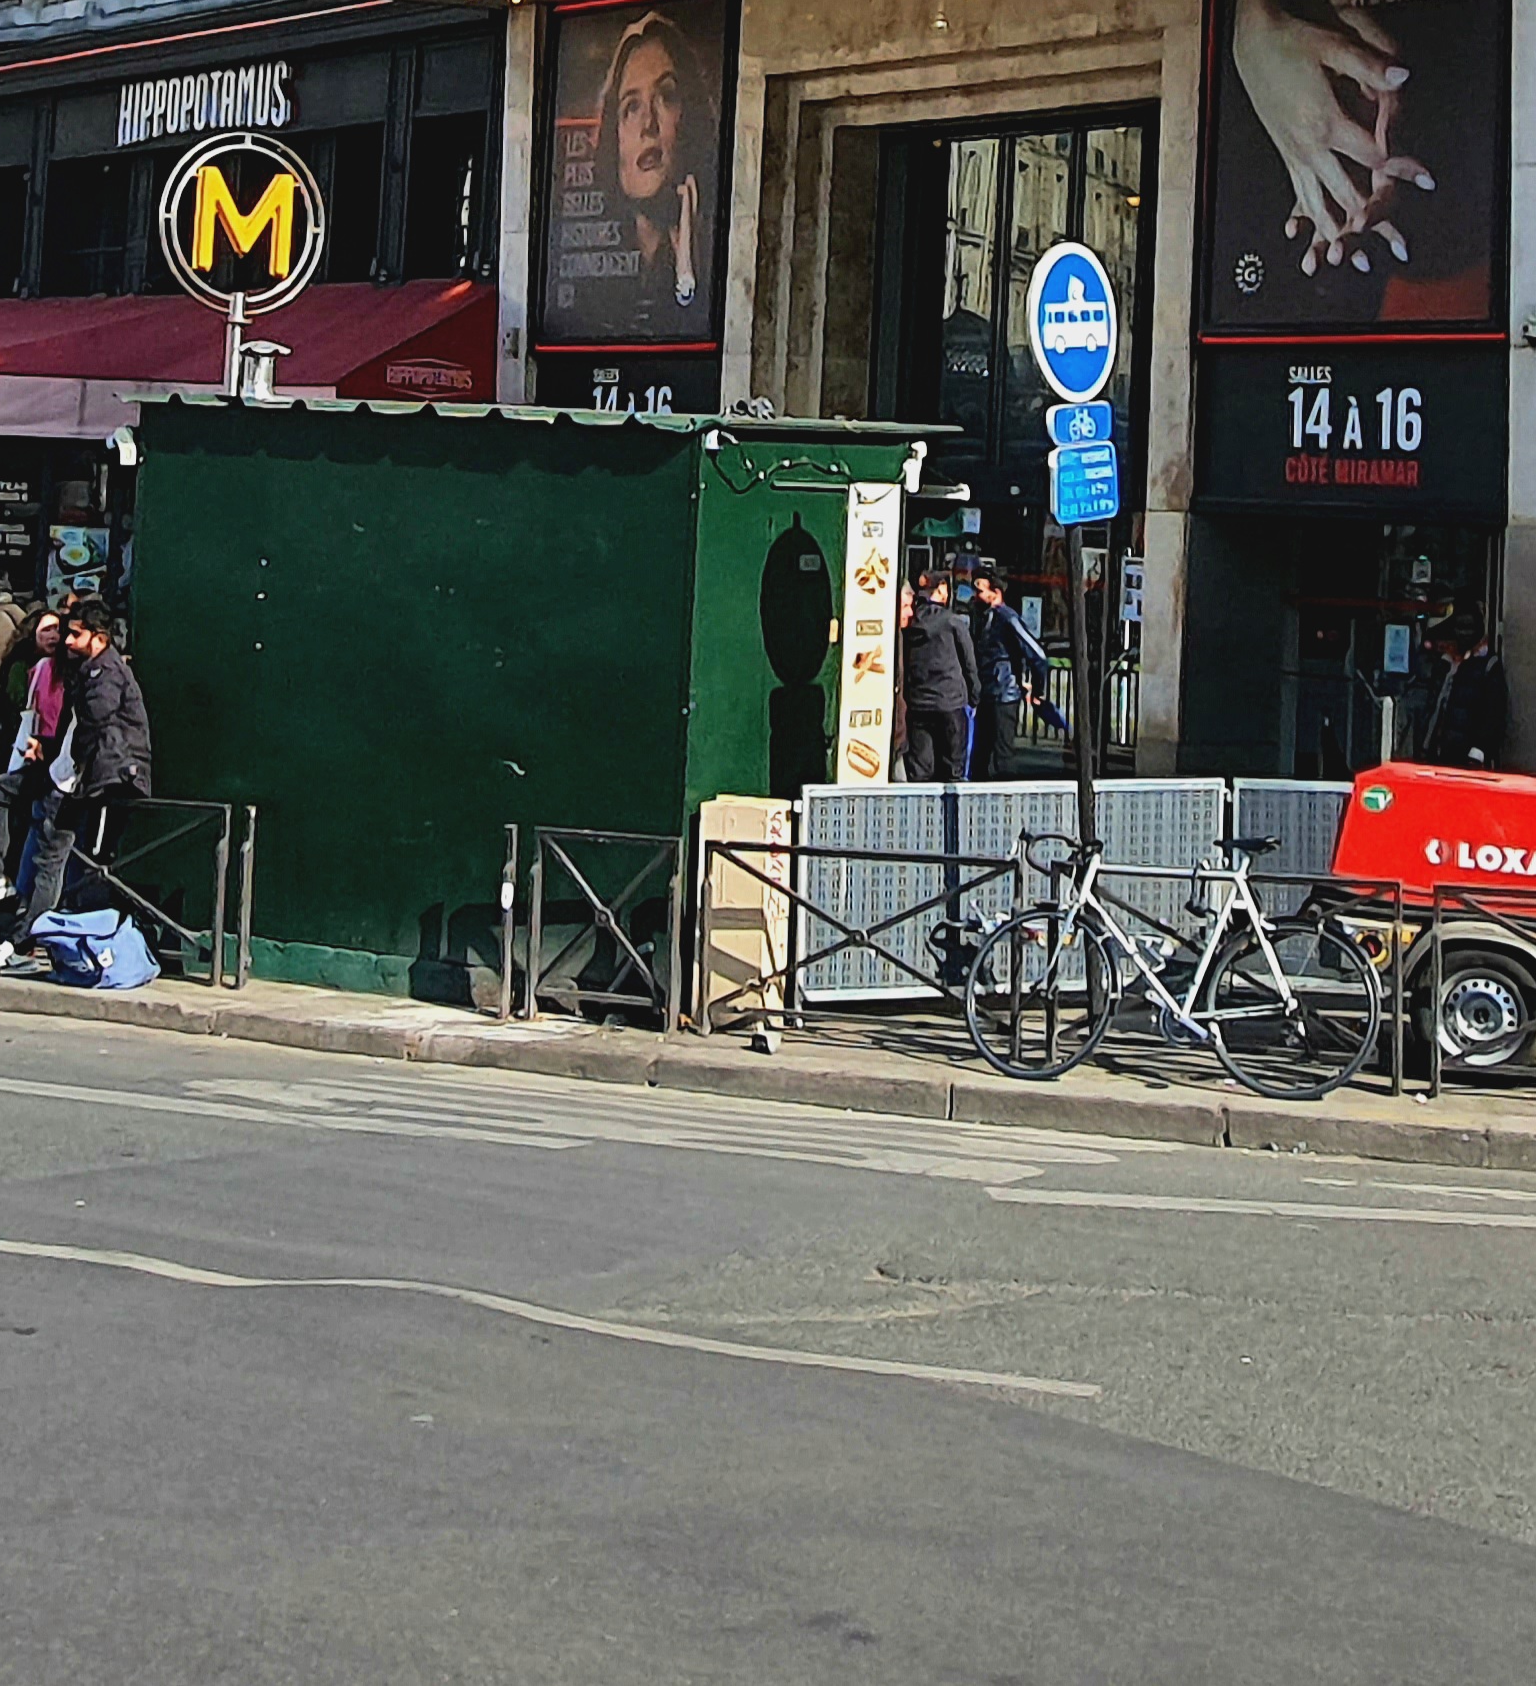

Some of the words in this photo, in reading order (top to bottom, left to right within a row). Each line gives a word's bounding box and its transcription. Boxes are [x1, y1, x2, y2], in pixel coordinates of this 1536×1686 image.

[117, 60, 292, 147] HIPPOPOTAMUS
[192, 166, 295, 279] M
[1288, 386, 1332, 449] 14
[1343, 396, 1363, 449] À
[1375, 387, 1422, 451] 16
[1335, 458, 1418, 487] MIRAMAR
